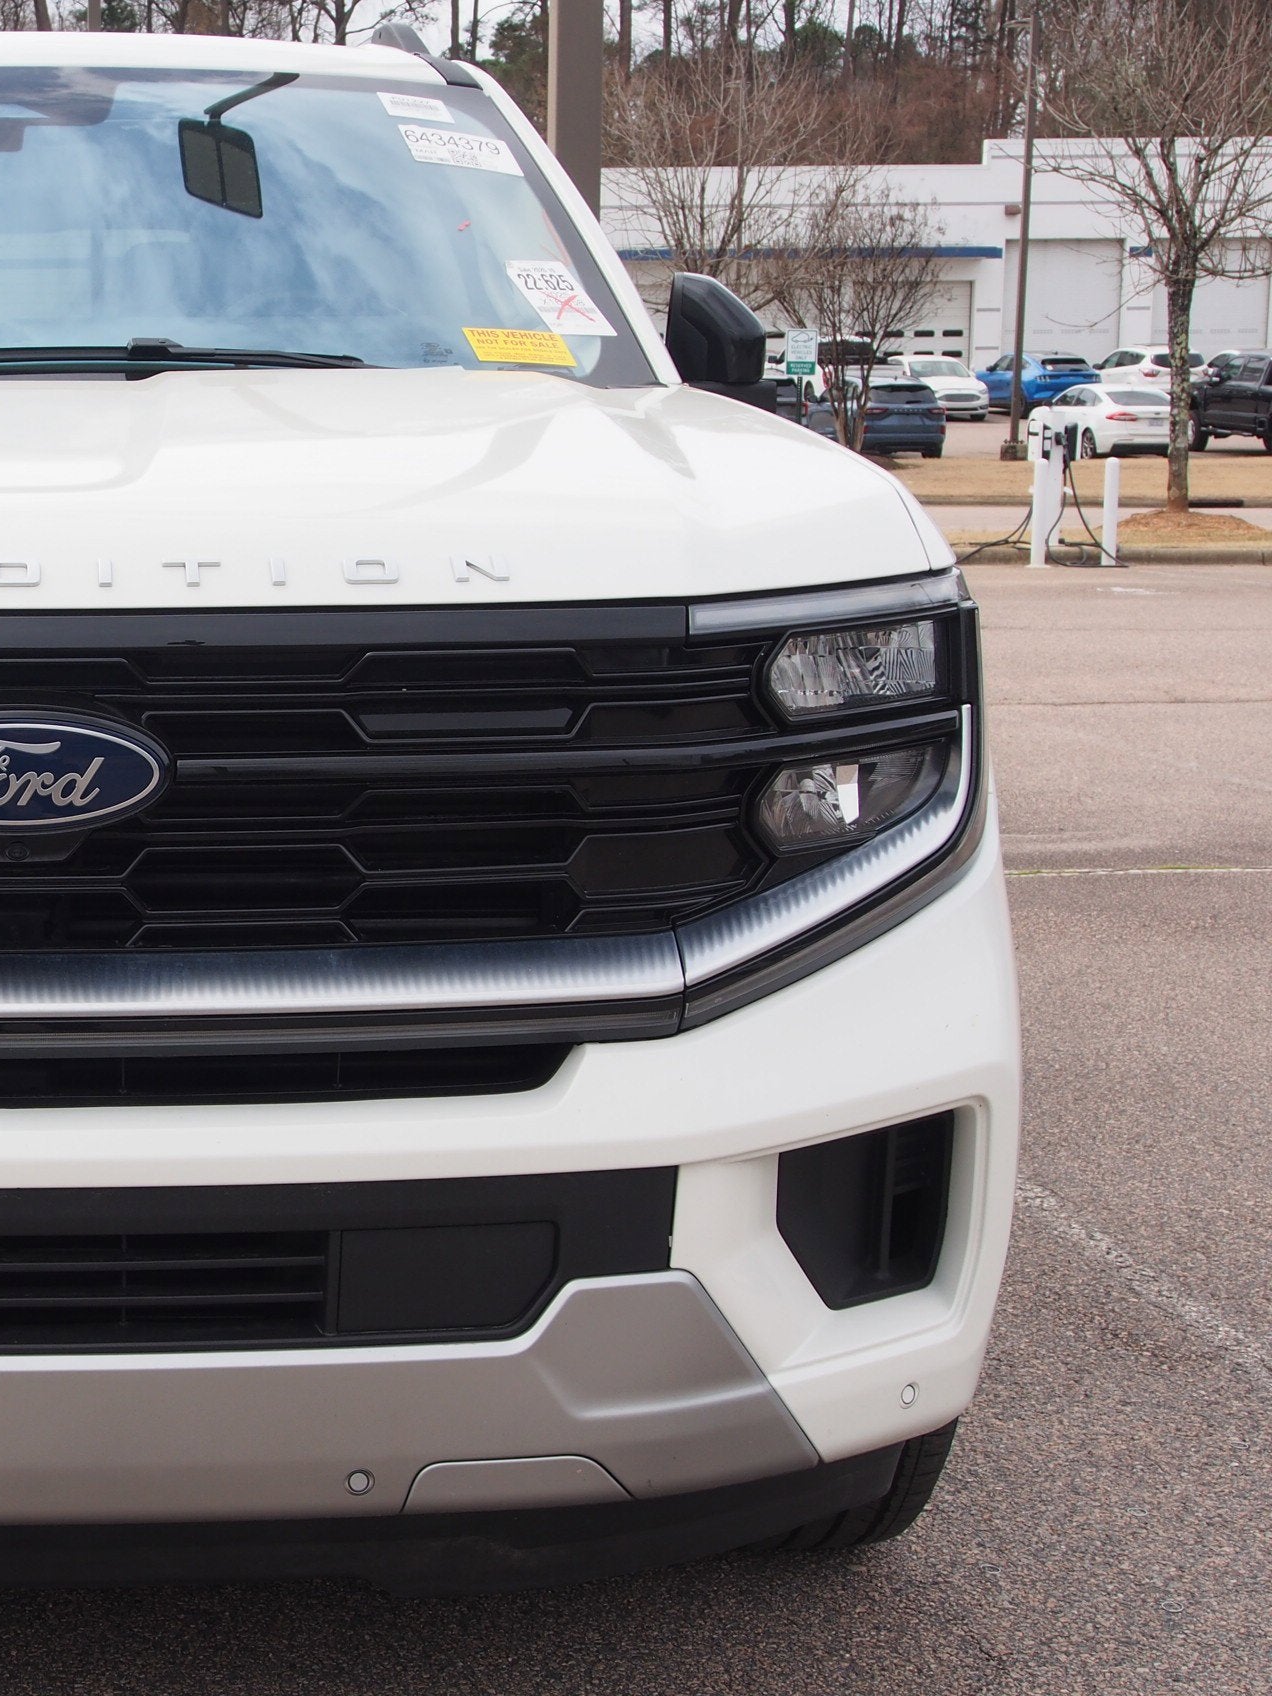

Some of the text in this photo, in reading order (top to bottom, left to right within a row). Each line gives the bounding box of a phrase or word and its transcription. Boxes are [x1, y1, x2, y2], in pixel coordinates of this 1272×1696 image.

[404, 129, 500, 155] 6434379
[468, 330, 558, 342] THIS VEHICLE
[503, 339, 527, 347] FOR
[530, 341, 559, 349] SALE
